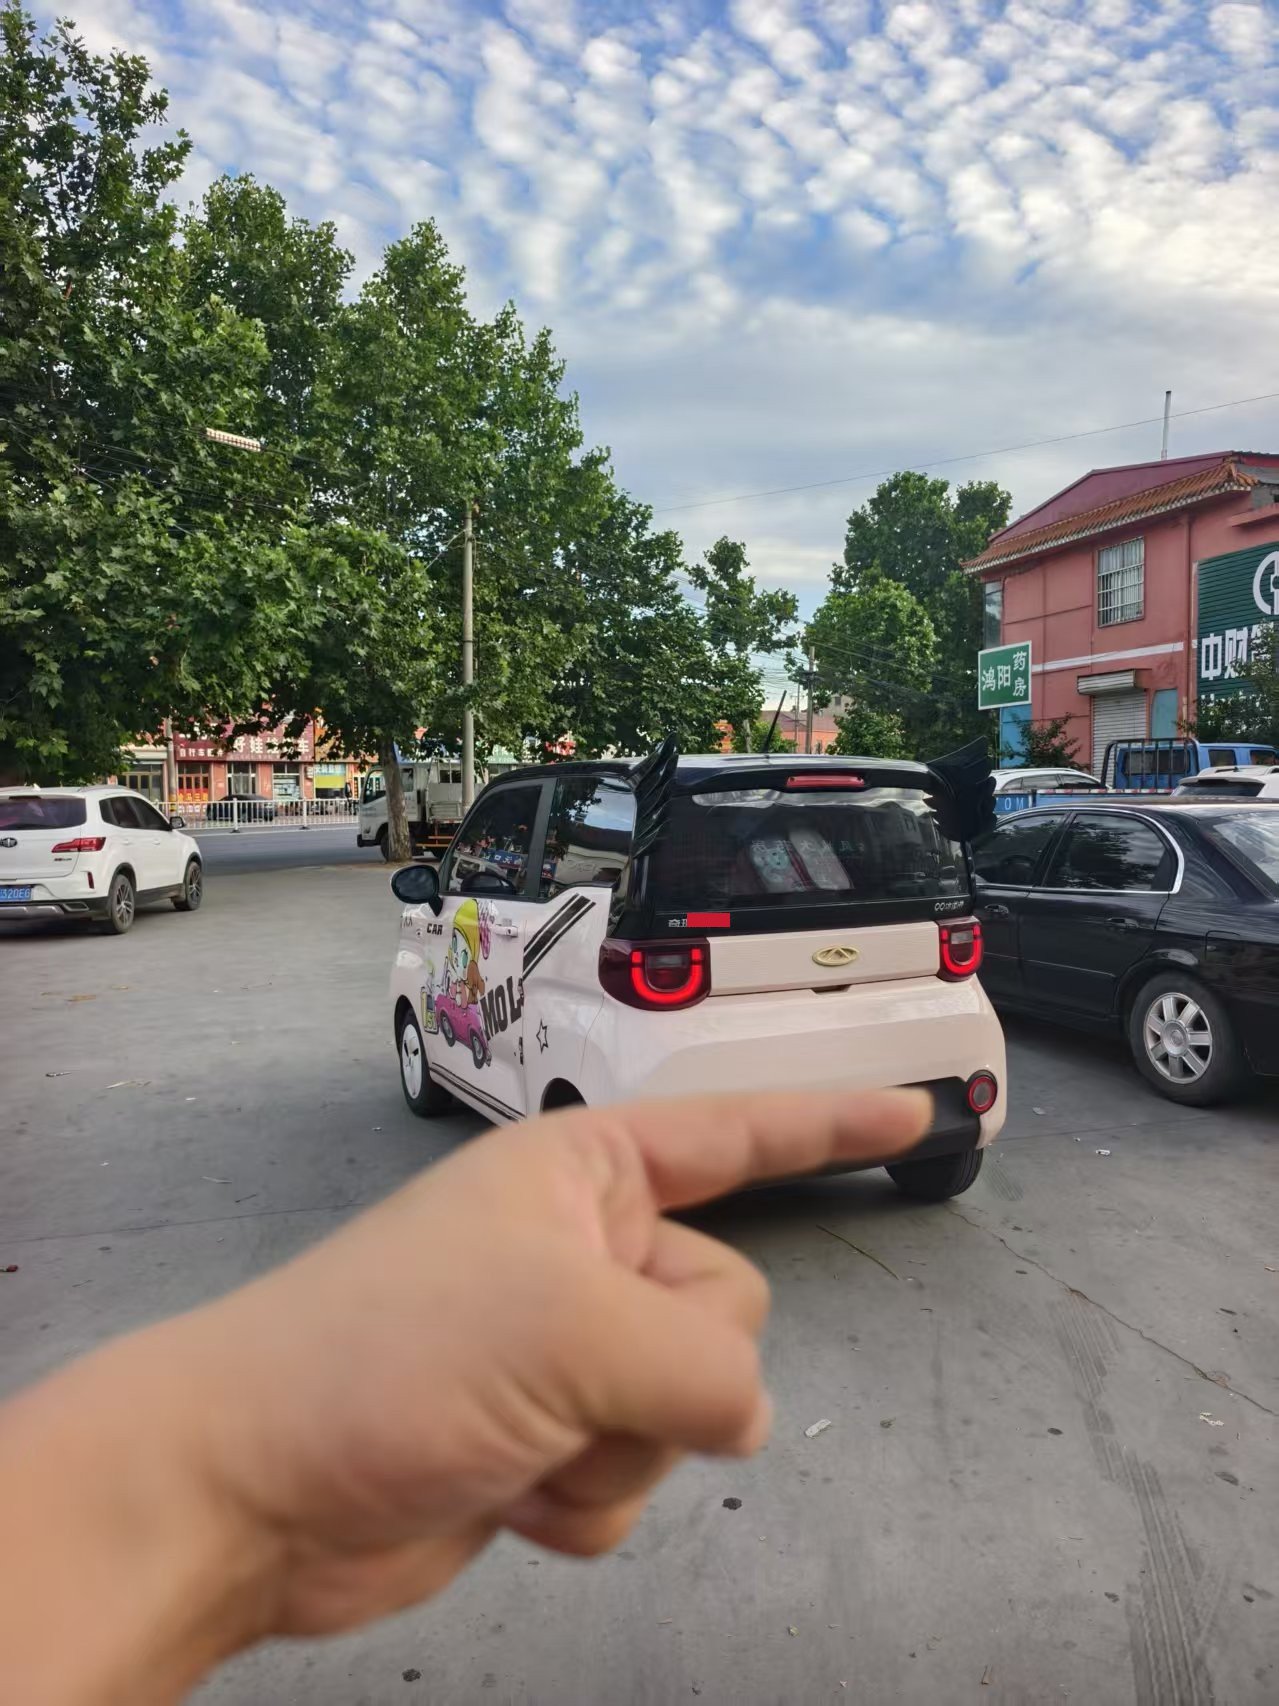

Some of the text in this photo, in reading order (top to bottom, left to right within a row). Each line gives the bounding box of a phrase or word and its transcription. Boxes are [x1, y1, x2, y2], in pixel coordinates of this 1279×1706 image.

[982, 665, 1011, 692] 鸿阳
[1012, 651, 1027, 697] 药房
[427, 923, 443, 935] CAR
